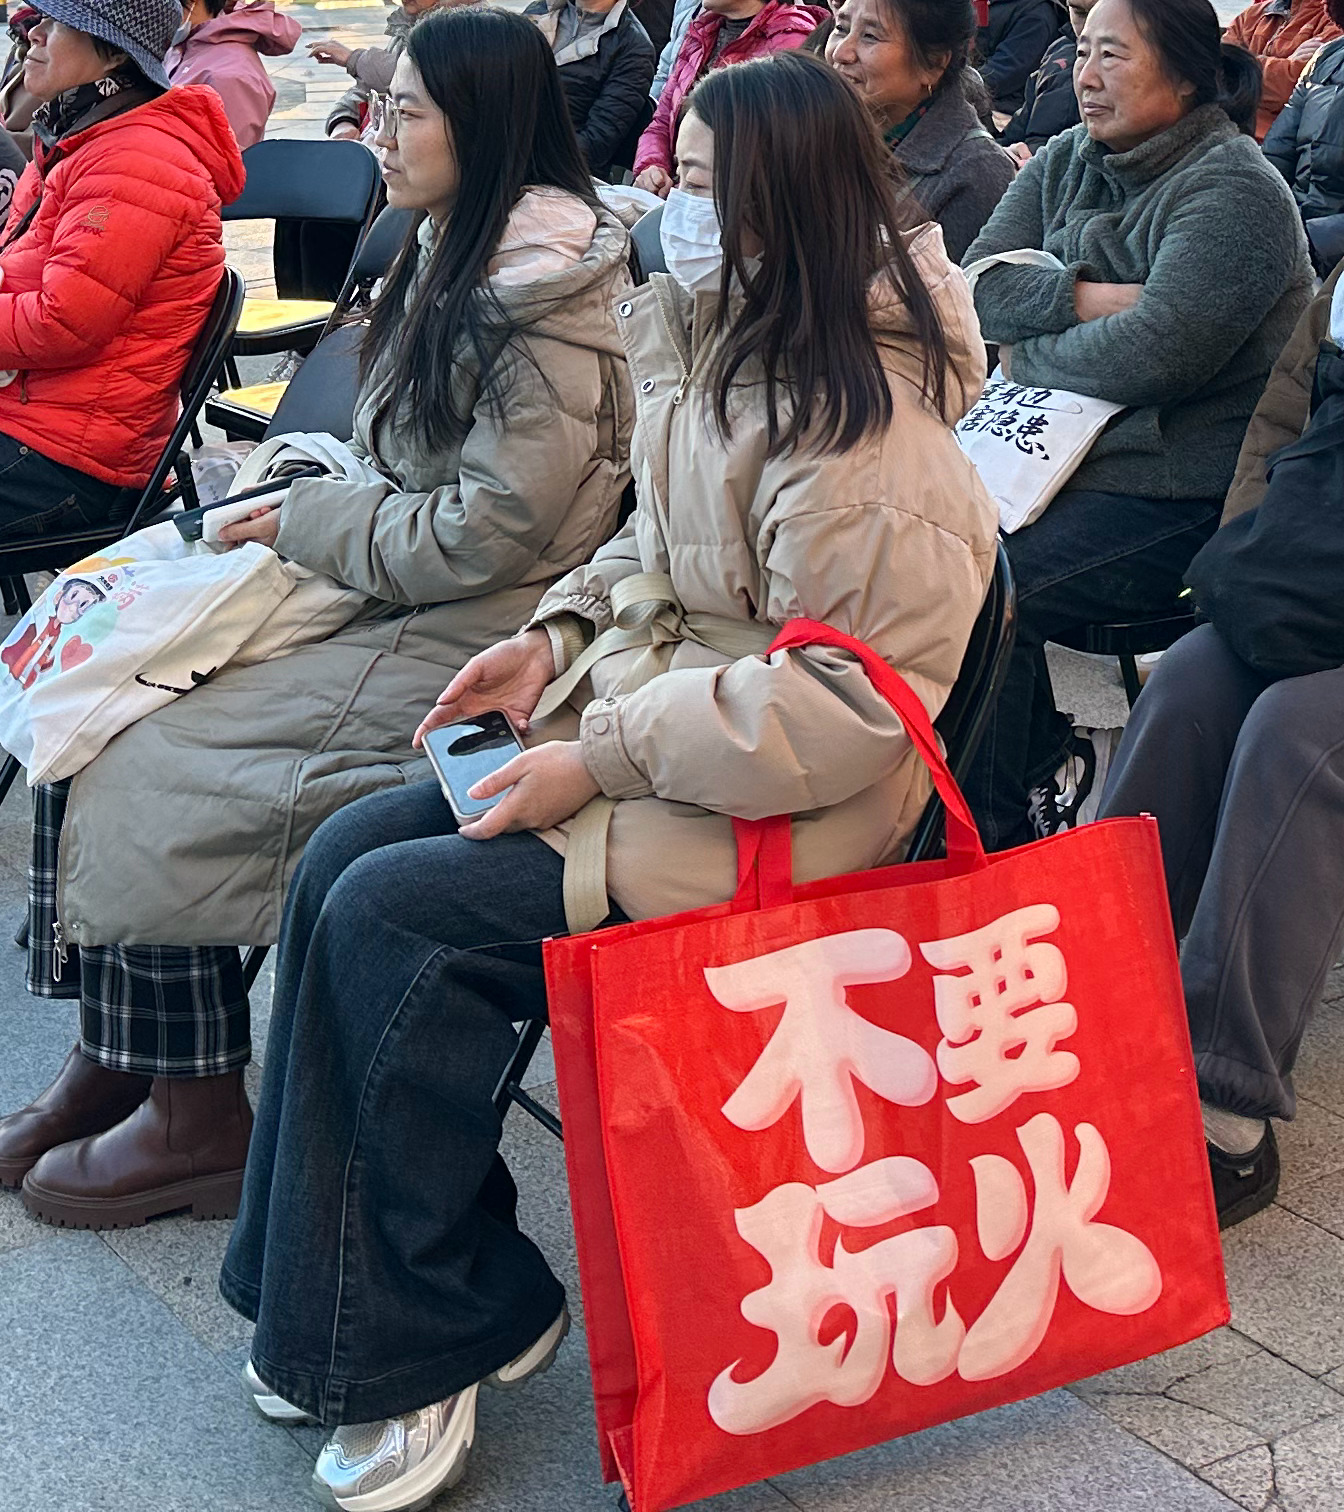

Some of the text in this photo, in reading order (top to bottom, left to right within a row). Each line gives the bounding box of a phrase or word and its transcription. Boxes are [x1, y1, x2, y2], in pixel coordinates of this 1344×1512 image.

[954, 404, 1050, 460] 害隐患
[703, 903, 1081, 1174] 不要
[707, 1113, 1163, 1435] 玩火
